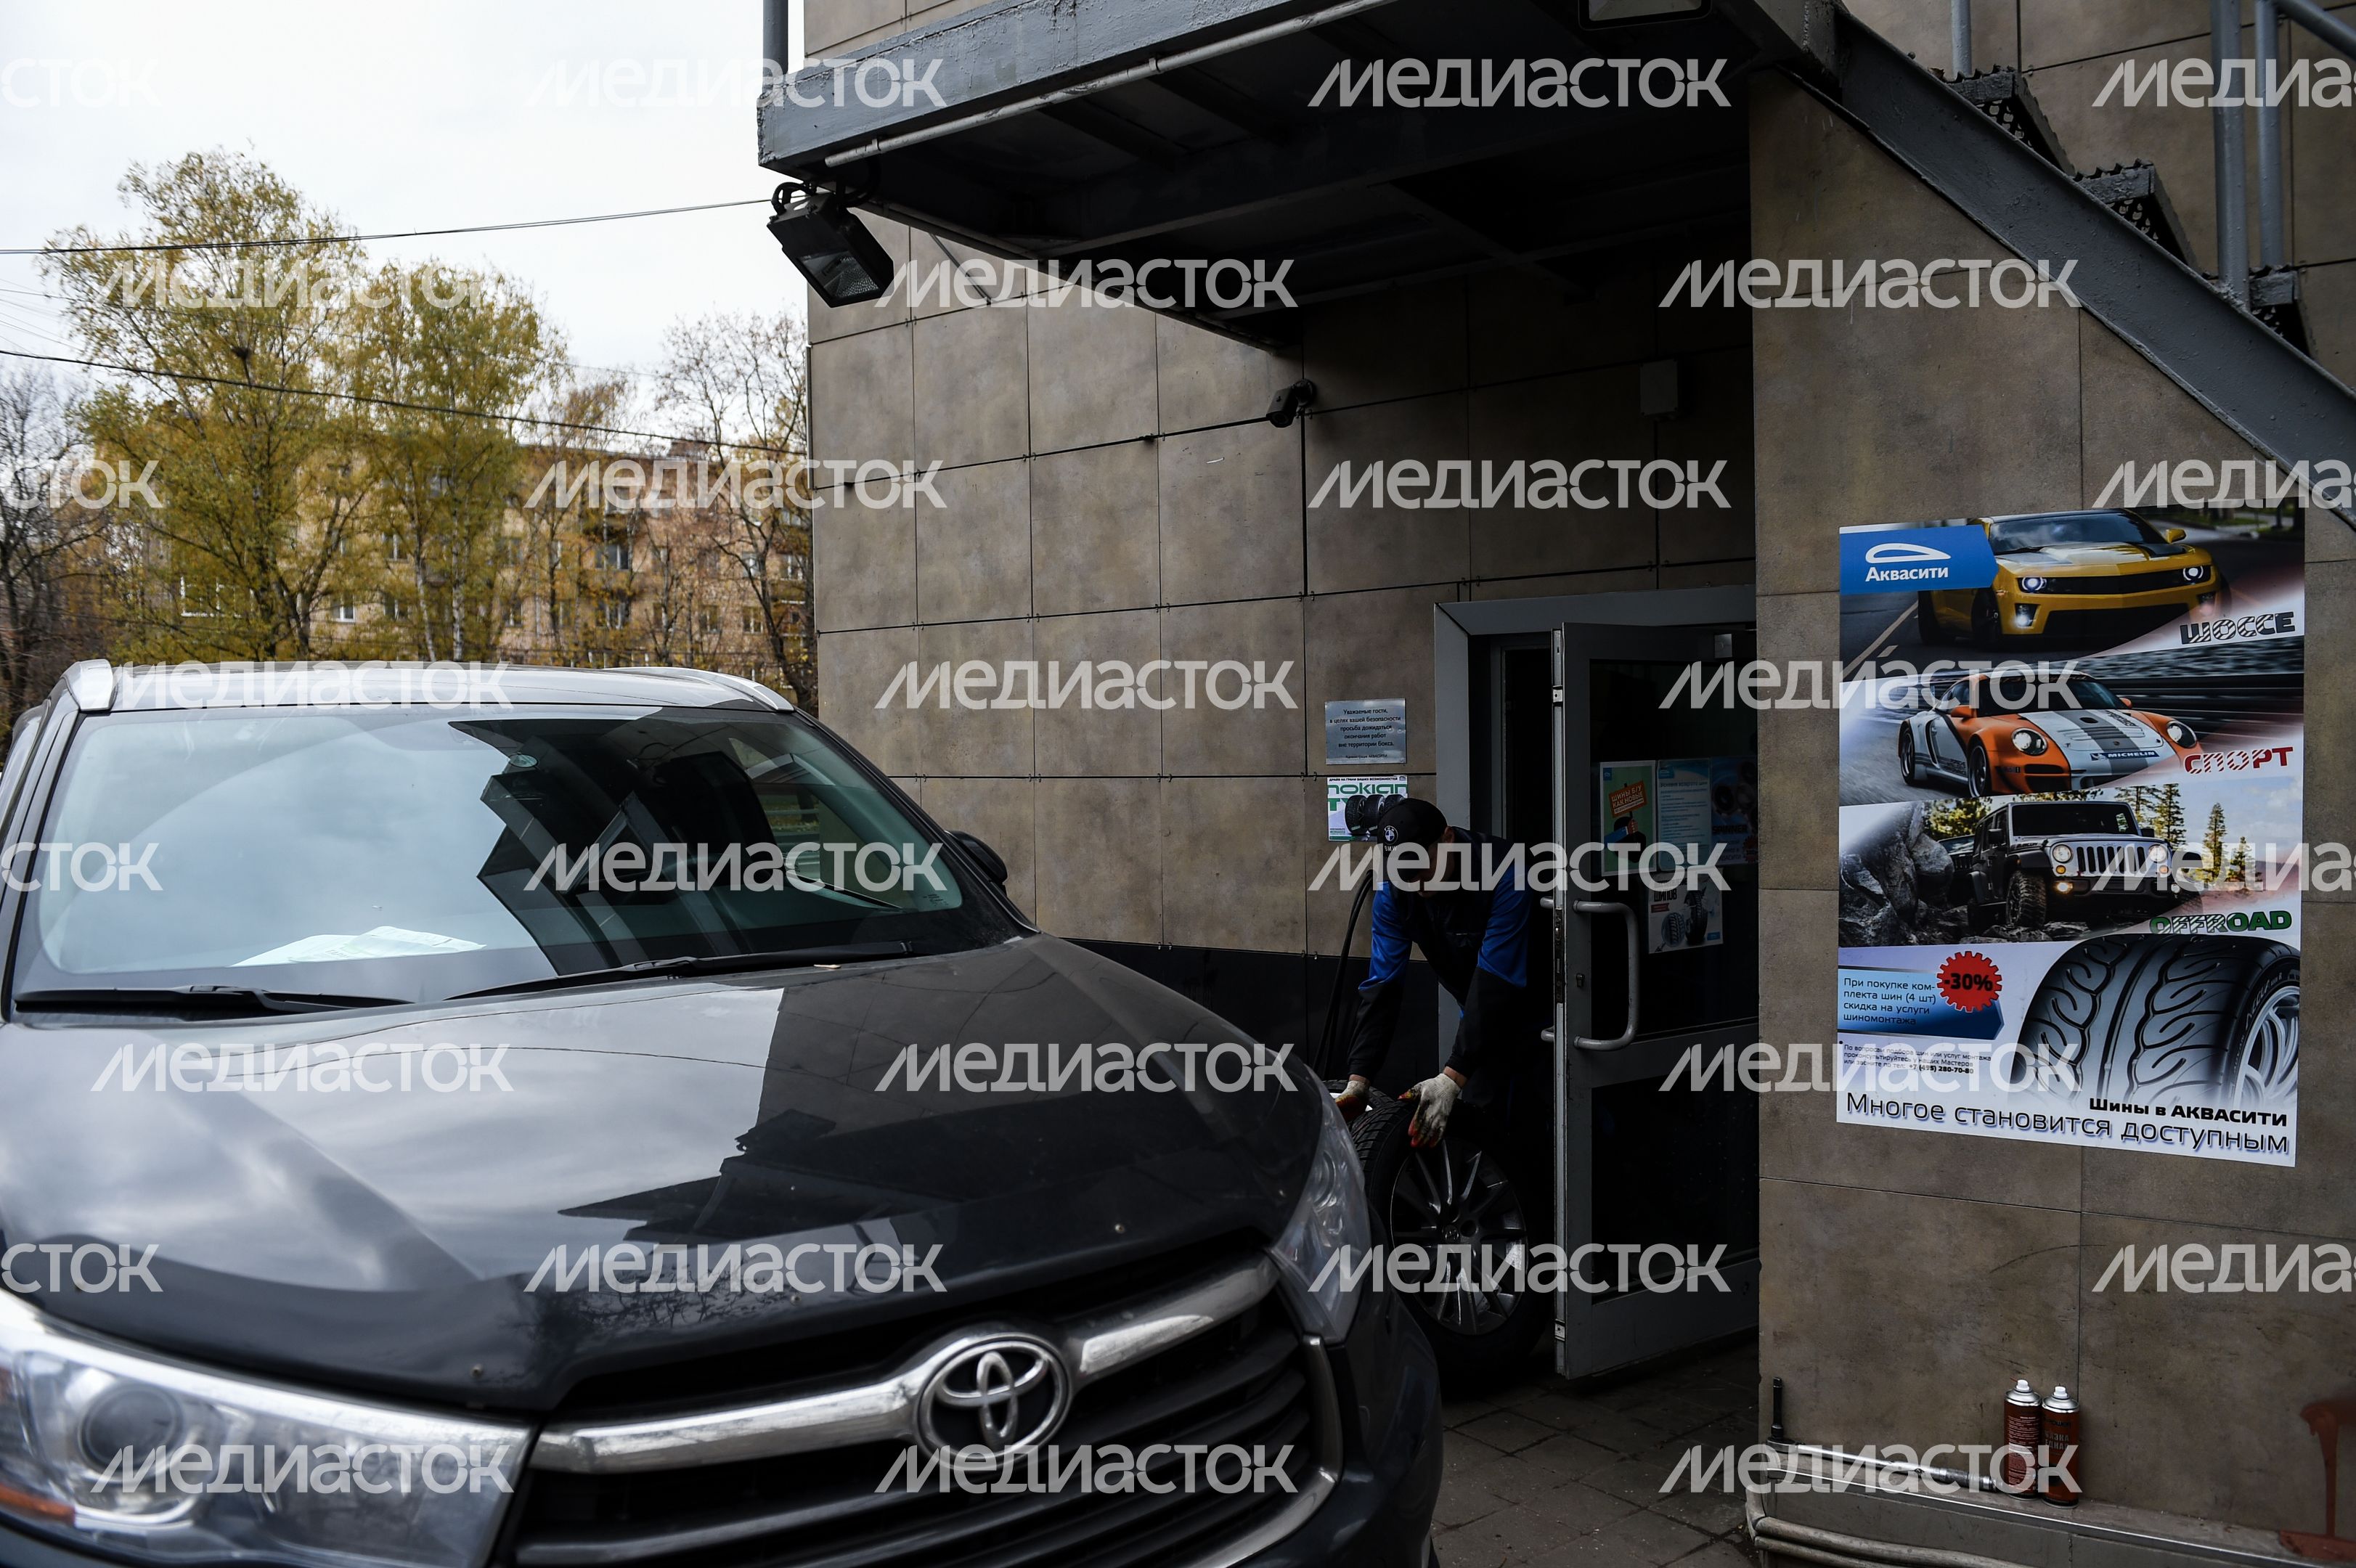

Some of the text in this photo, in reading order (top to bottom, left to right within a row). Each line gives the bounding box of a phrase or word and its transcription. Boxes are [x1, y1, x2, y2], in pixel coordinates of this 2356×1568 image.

[1865, 564, 1949, 582] Аквасити
[2180, 611, 2296, 645] ШОССЕ
[2185, 746, 2294, 775] СПОРТ
[1611, 788, 1631, 802] ШИНЫ
[1613, 798, 1625, 809] КАК
[1625, 791, 1644, 804] НОВЫЕ
[1654, 888, 1677, 902] ШИПОВ
[2149, 910, 2292, 934] OFFROAD
[1844, 978, 1936, 991] При покупке ком-
[1944, 973, 1993, 992] -30%
[1843, 990, 1936, 1005] плекта шин (4 шт)
[1843, 1001, 1878, 1012] скидка
[1896, 1005, 1930, 1015] услуги
[1843, 1013, 1917, 1025] шиномонтажа
[1938, 1065, 1974, 1074] 280-70-80
[1941, 1058, 1973, 1067] Мастеров
[2090, 1097, 2287, 1127] Шины в АКВАСИТИ
[1847, 1093, 2288, 1153] Многое становится доступным
